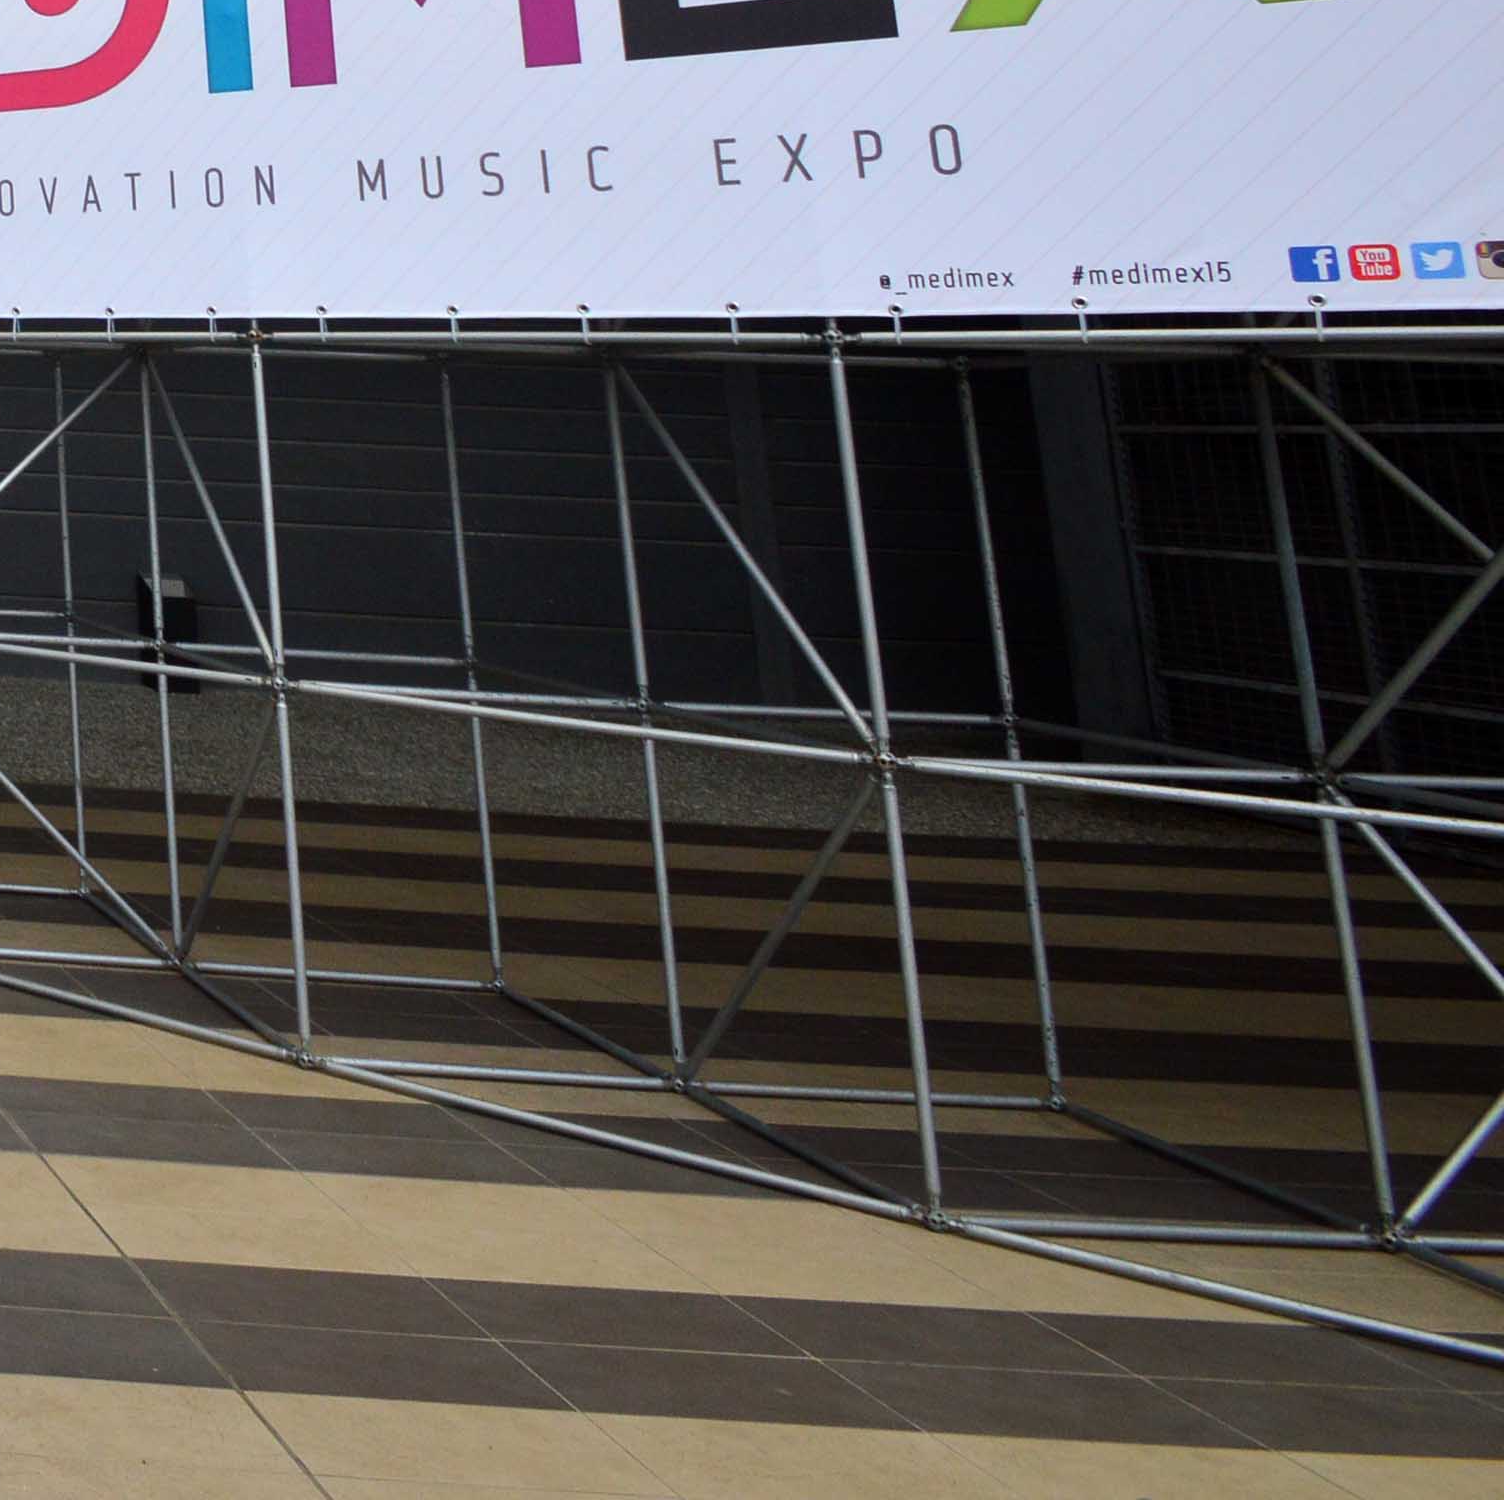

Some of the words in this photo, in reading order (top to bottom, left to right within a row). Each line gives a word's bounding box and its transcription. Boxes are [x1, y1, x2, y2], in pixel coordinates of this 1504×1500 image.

[355, 144, 614, 202] MUSIC
[711, 123, 964, 187] EXPO
[1358, 250, 1386, 262] You
[1071, 261, 1232, 286] #medimex15
[1357, 262, 1394, 277] Tube
